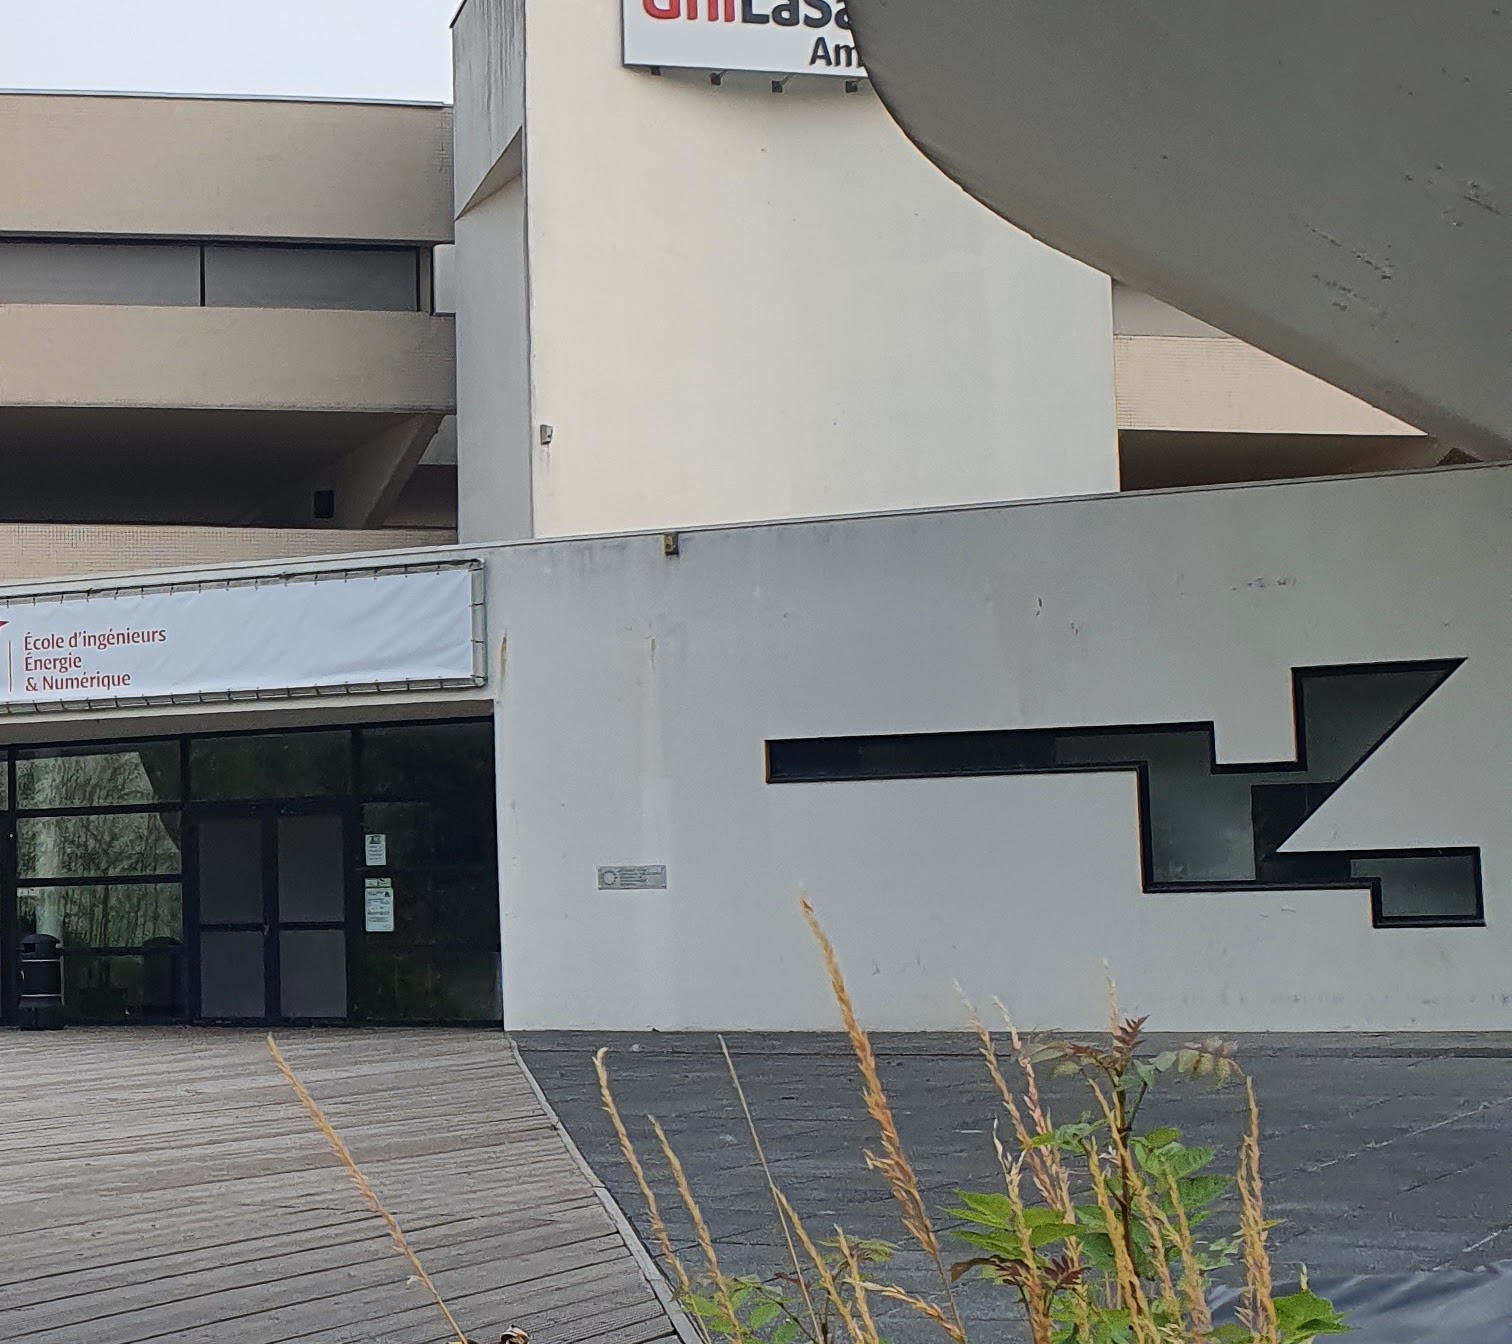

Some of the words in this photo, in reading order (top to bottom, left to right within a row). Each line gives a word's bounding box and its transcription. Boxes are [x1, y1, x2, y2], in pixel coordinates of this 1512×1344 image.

[24, 631, 64, 652] École
[68, 627, 167, 650] d'ingénieurs
[24, 652, 83, 673] Énergie
[25, 676, 39, 692] &
[42, 671, 131, 691] Numérique
